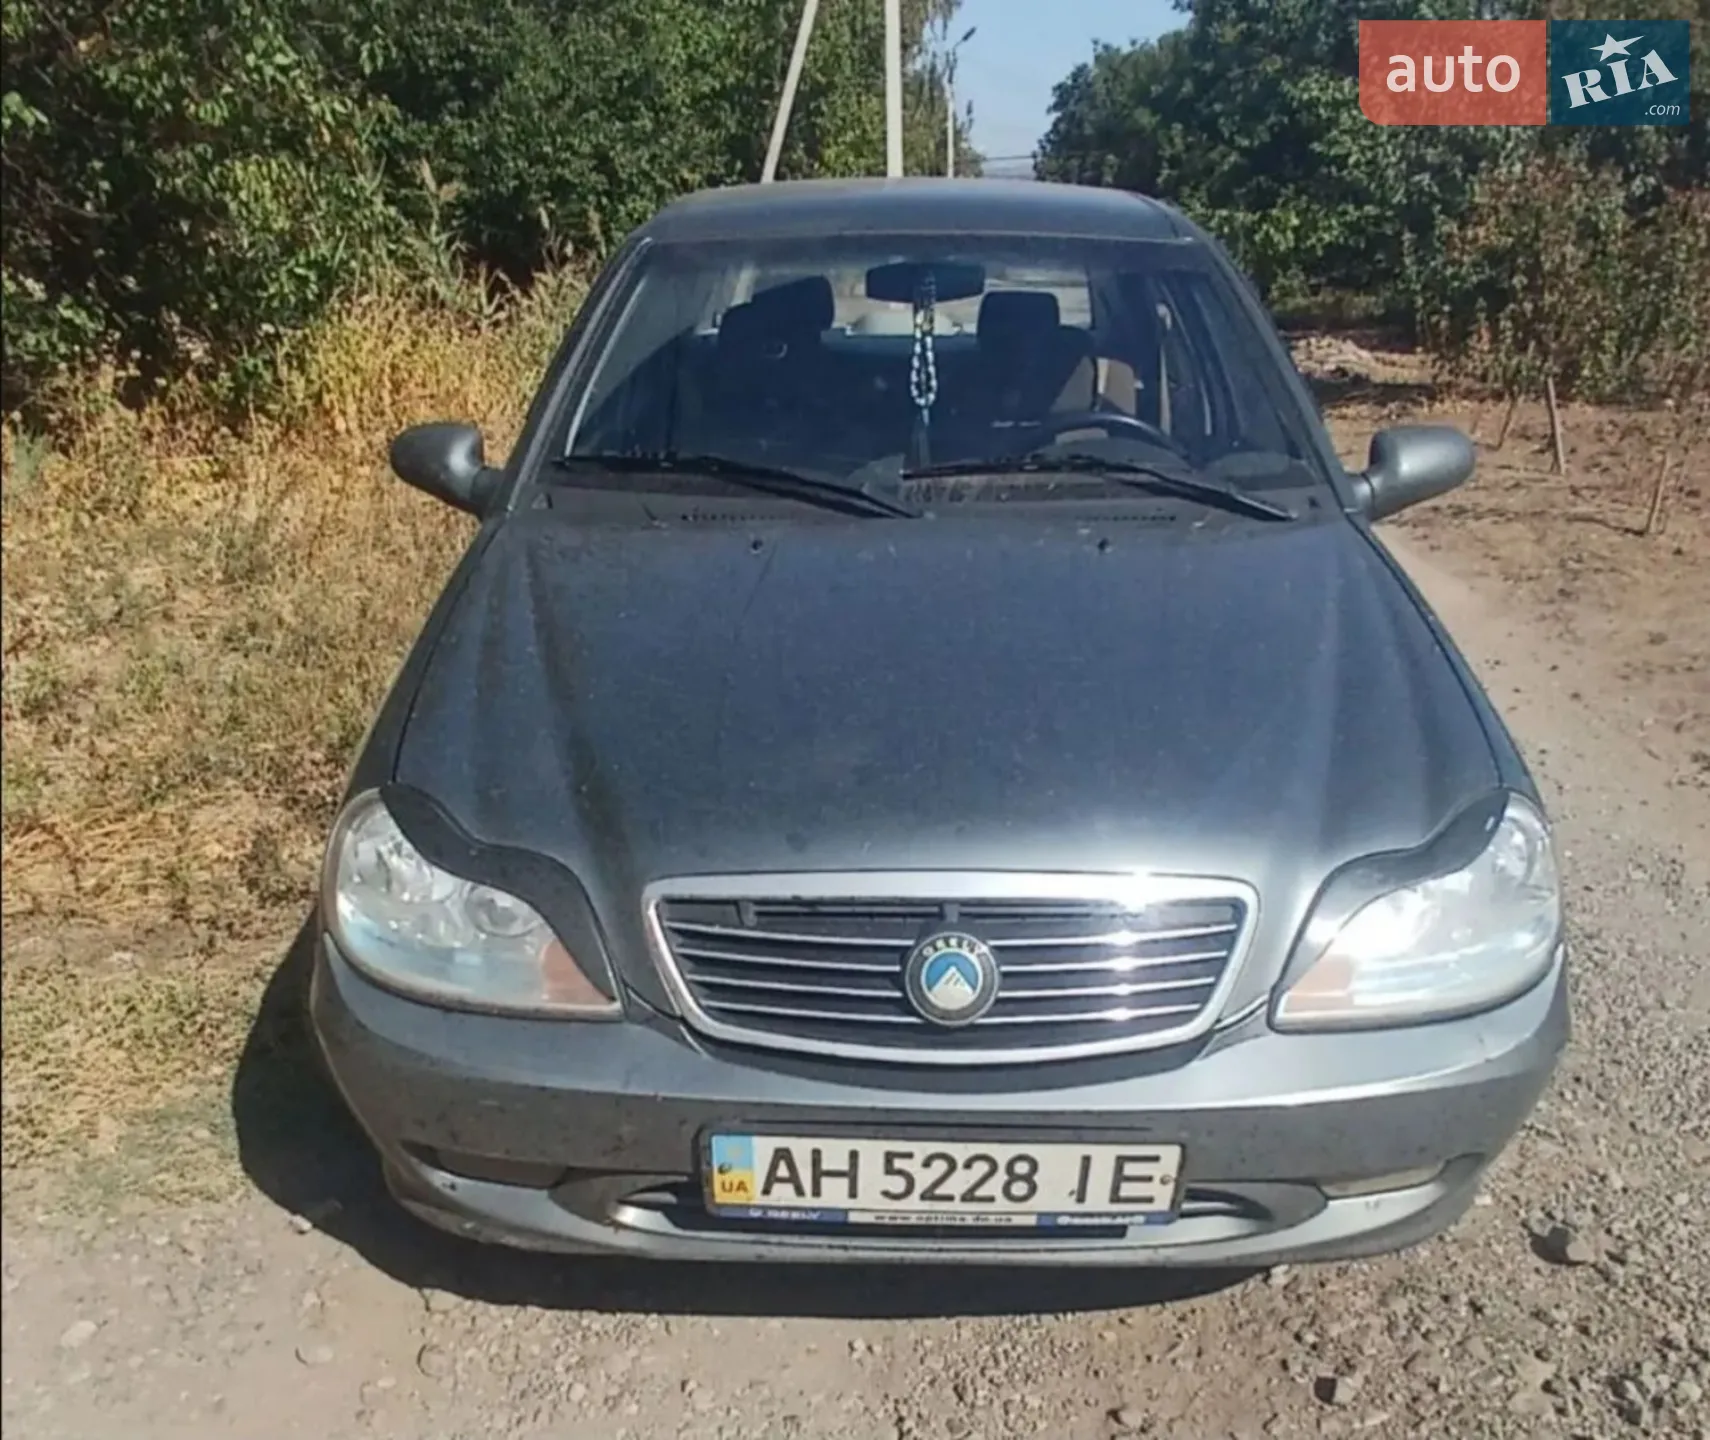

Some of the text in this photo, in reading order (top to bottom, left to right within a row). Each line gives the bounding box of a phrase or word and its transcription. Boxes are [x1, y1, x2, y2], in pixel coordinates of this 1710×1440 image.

[721, 1180, 749, 1194] UA
[761, 1146, 1161, 1204] AH 5228 IE
